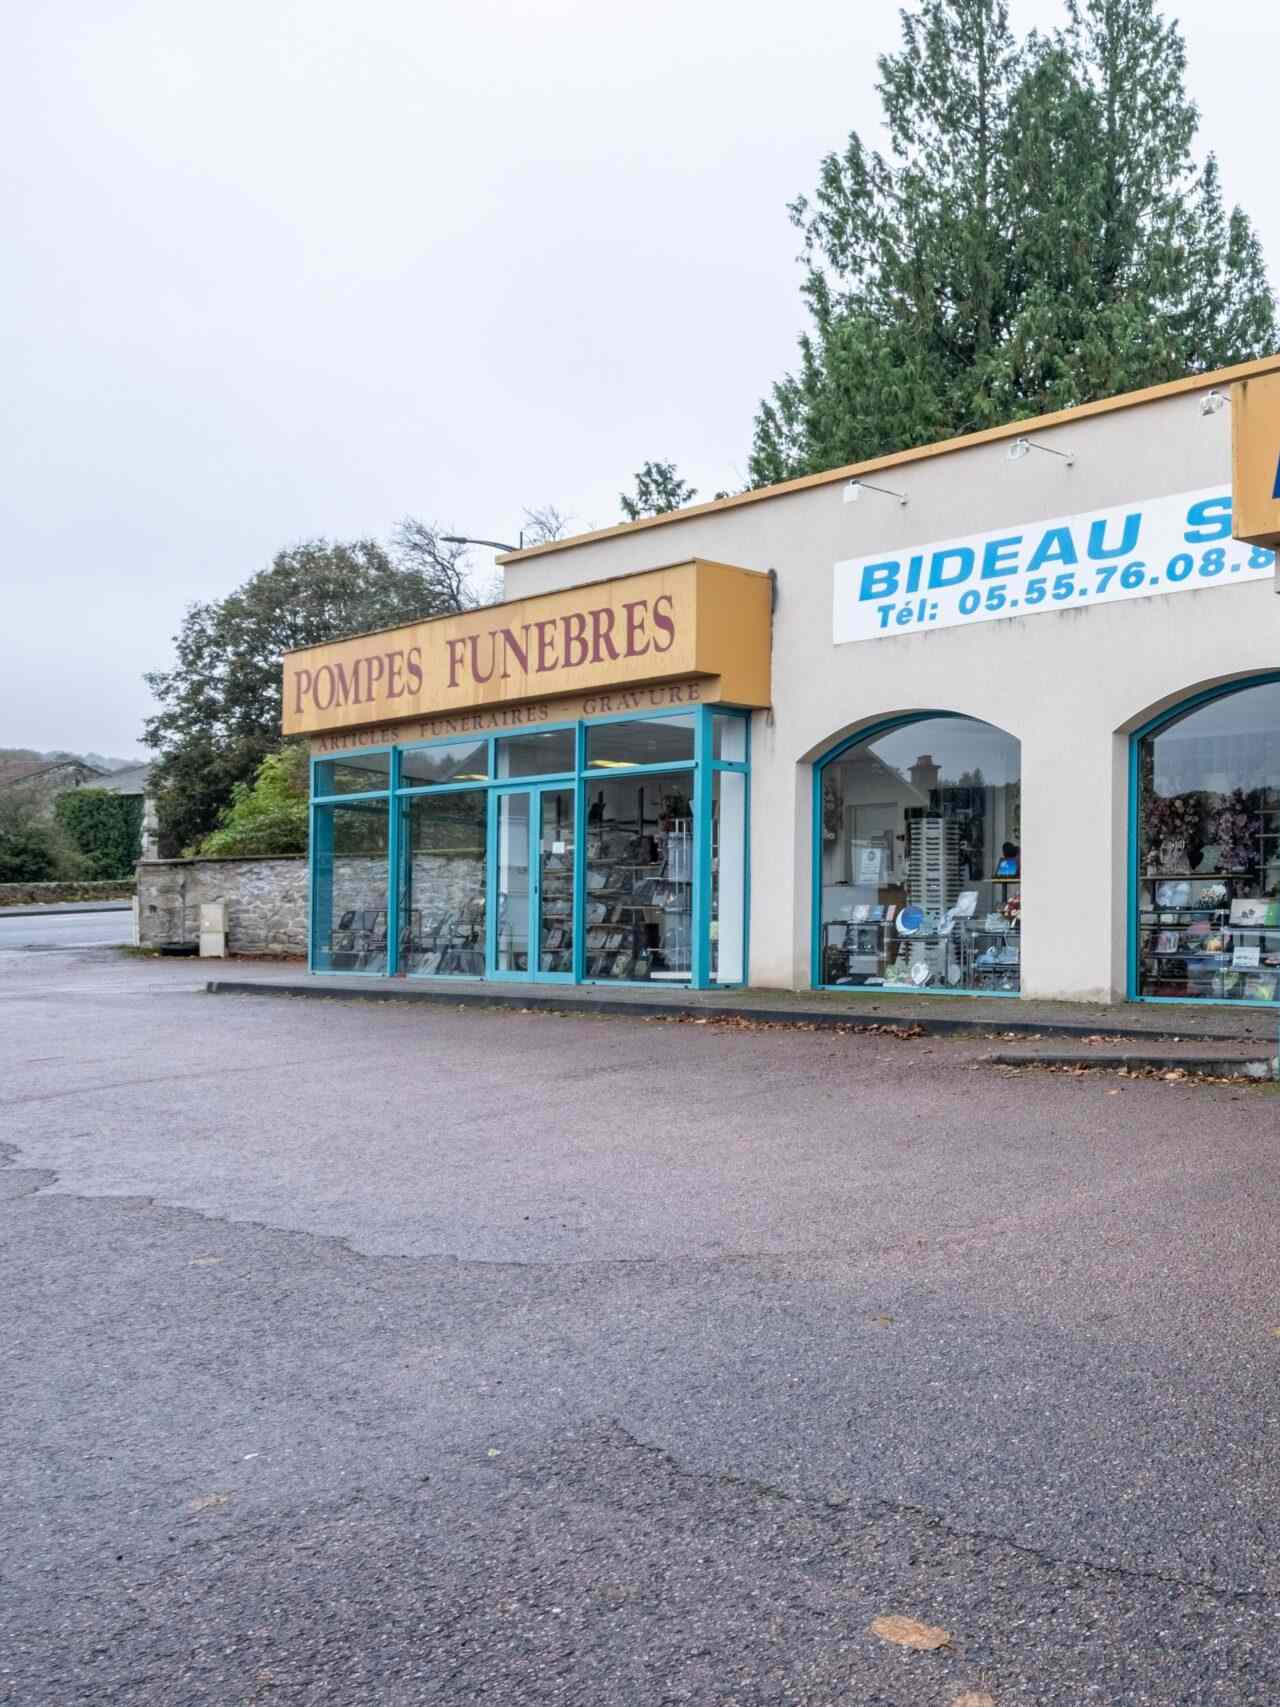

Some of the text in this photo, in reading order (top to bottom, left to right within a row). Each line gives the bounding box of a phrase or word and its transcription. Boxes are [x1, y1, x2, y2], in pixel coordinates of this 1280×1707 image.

[858, 495, 1233, 602] BIDEAU S
[293, 594, 676, 714] POMPES FUNEBRES
[877, 598, 939, 629] Tél:
[318, 726, 400, 752] ARTICLES
[583, 683, 702, 716] GRAVURE
